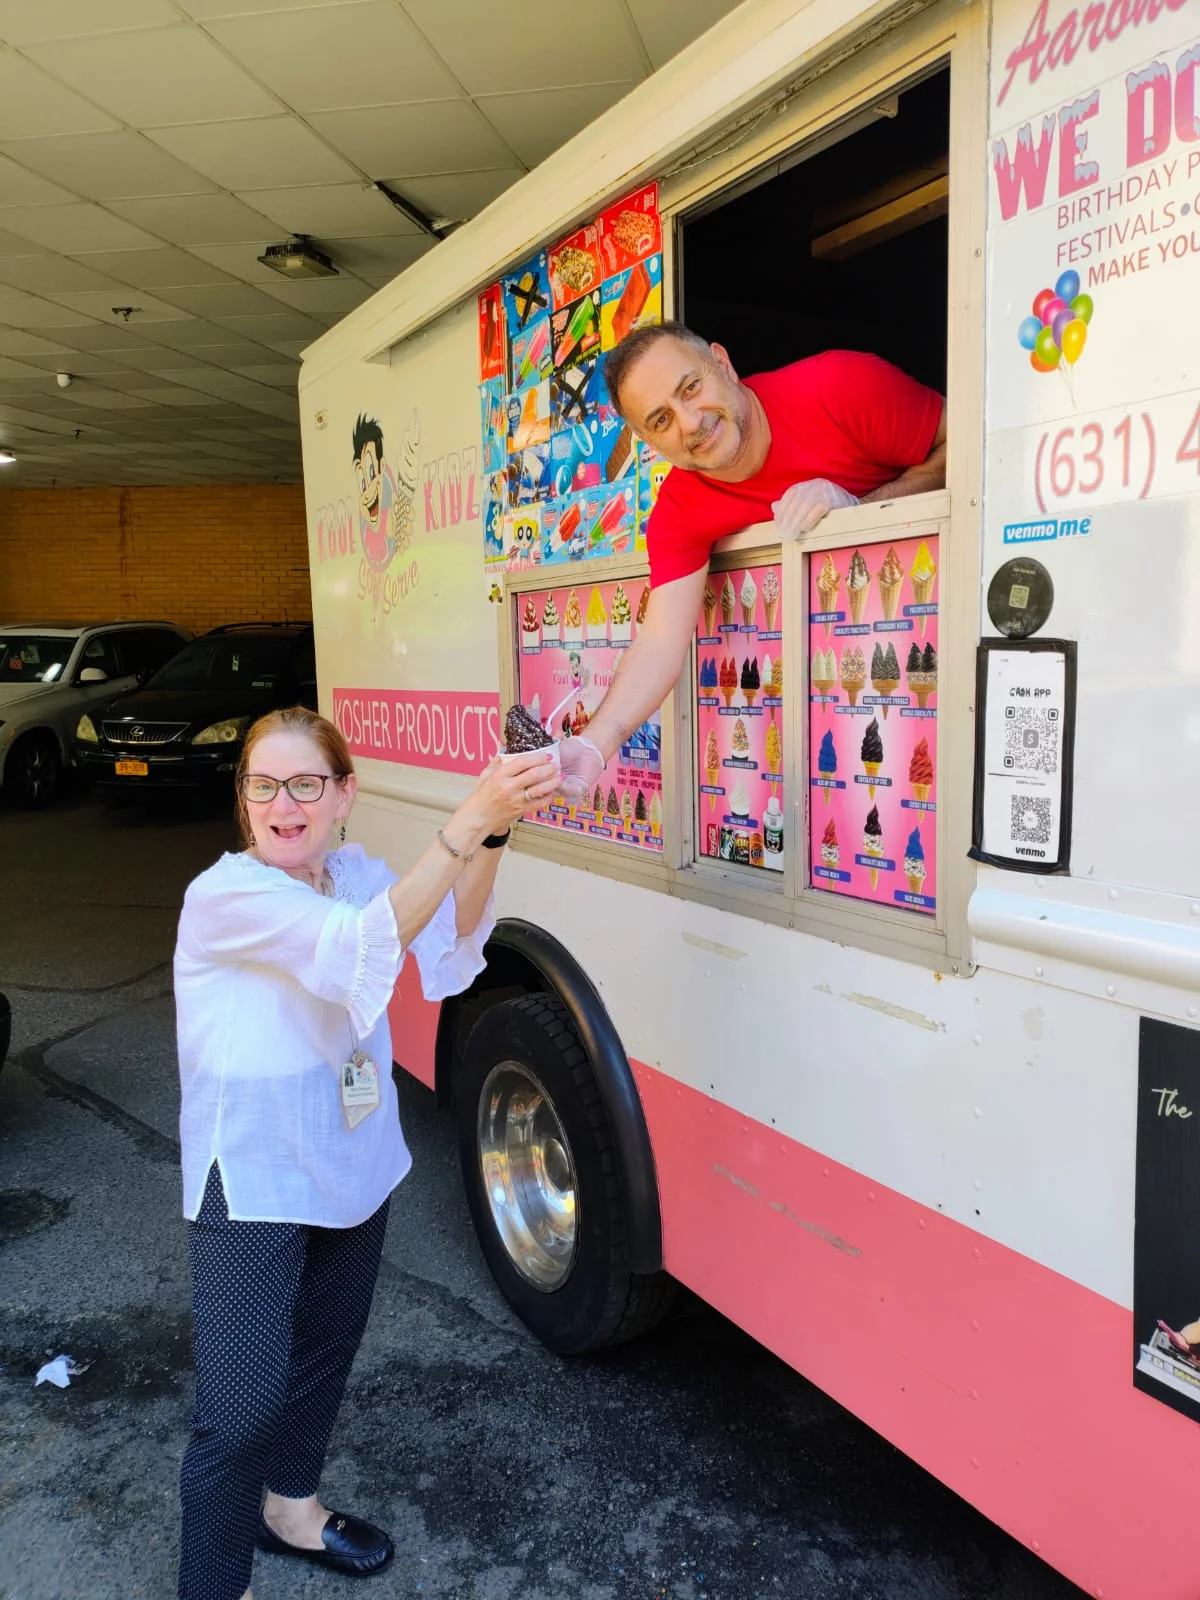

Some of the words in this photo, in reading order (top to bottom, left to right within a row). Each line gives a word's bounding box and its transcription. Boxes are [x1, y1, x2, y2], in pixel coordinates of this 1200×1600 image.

[992, 89, 1099, 221] WE
[1057, 159, 1178, 230] BIRTHDAY
[1088, 247, 1150, 288] MAKE
[423, 445, 480, 533] KIDZ
[1034, 411, 1156, 515] (631)
[1006, 522, 1055, 540] venmo
[1060, 518, 1091, 536] me
[1010, 687, 1031, 697] CASH
[334, 699, 393, 749] KOSHER
[395, 702, 501, 762] PRODUCTS
[1016, 847, 1046, 858] venmo
[1151, 1088, 1193, 1118] The
